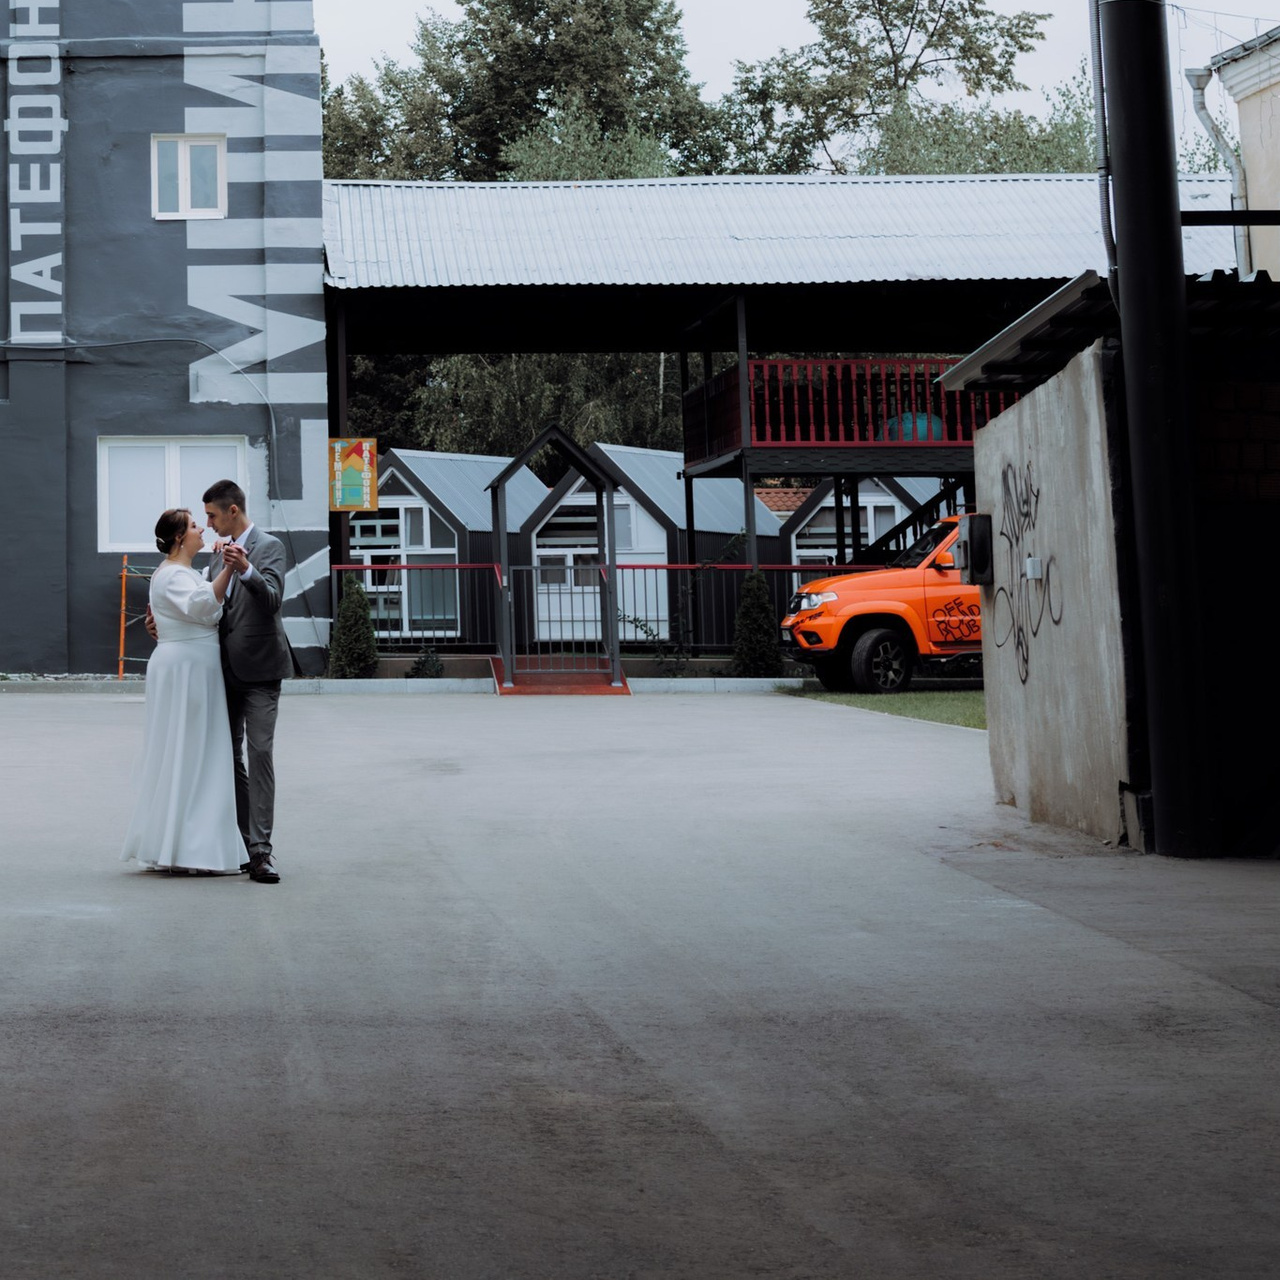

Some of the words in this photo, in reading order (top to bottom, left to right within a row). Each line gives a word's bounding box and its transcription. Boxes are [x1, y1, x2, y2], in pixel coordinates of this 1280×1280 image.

[334, 442, 342, 508] КЕМПИНГ
[361, 442, 372, 508] ПАТЕФОНКА
[932, 597, 964, 623] OFF
